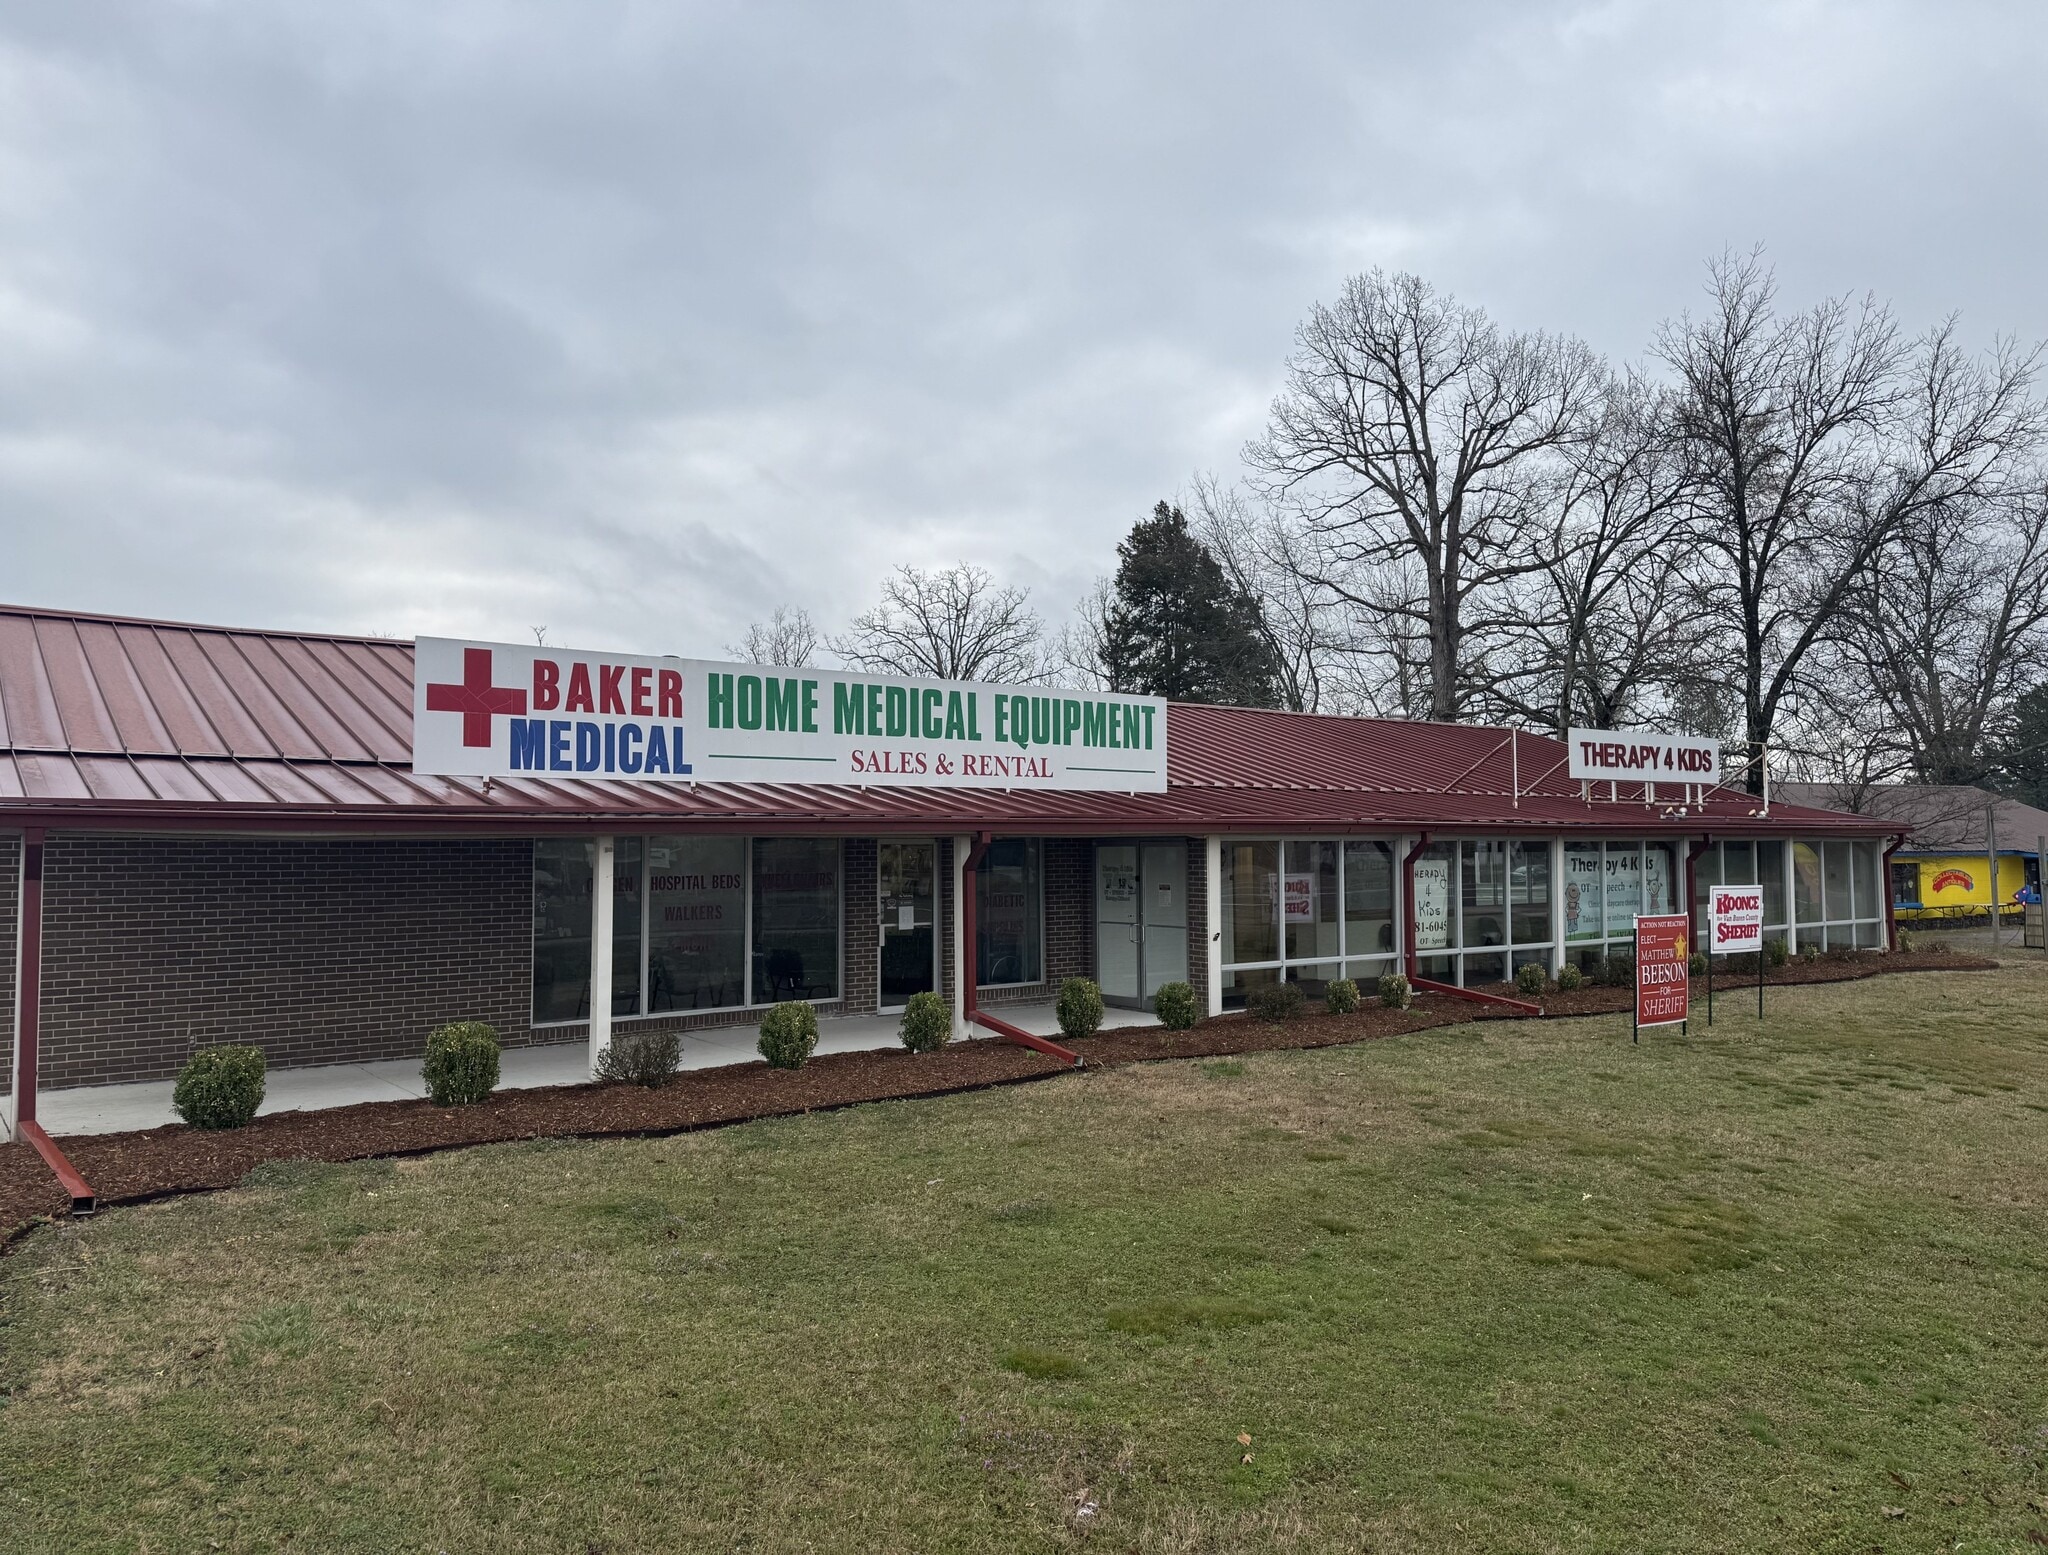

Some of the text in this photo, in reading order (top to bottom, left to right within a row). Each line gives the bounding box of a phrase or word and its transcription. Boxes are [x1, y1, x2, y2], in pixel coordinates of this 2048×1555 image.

[533, 659, 684, 719] BAKER
[708, 672, 1156, 750] HOME MEDICAL EQUIPMENT
[509, 718, 693, 775] MEDICAL
[851, 749, 1055, 779] SALES & RENTAL
[1580, 741, 1713, 773] THERAPY 4 KIDS
[1571, 856, 1618, 876] Therpy
[1621, 856, 1628, 871] 4
[586, 876, 633, 892] OGEN
[651, 874, 707, 891] HOSPITAL
[712, 874, 741, 889] BEDS
[1415, 869, 1447, 890] HERAPY
[1581, 883, 1590, 892] OT
[1607, 882, 1625, 894] peech
[1425, 884, 1431, 896] 4
[664, 905, 722, 921] WALKERS
[1625, 898, 1640, 908] therap
[1716, 893, 1760, 914] KOONCE
[1658, 919, 1667, 927] NOT
[1717, 922, 1760, 943] SHERIFF
[1641, 934, 1656, 944] ELECT
[1641, 947, 1674, 961] MATTHEW
[1641, 962, 1685, 985] BEESON
[1660, 985, 1671, 995] FOR
[1643, 996, 1684, 1016] SHERIFF
